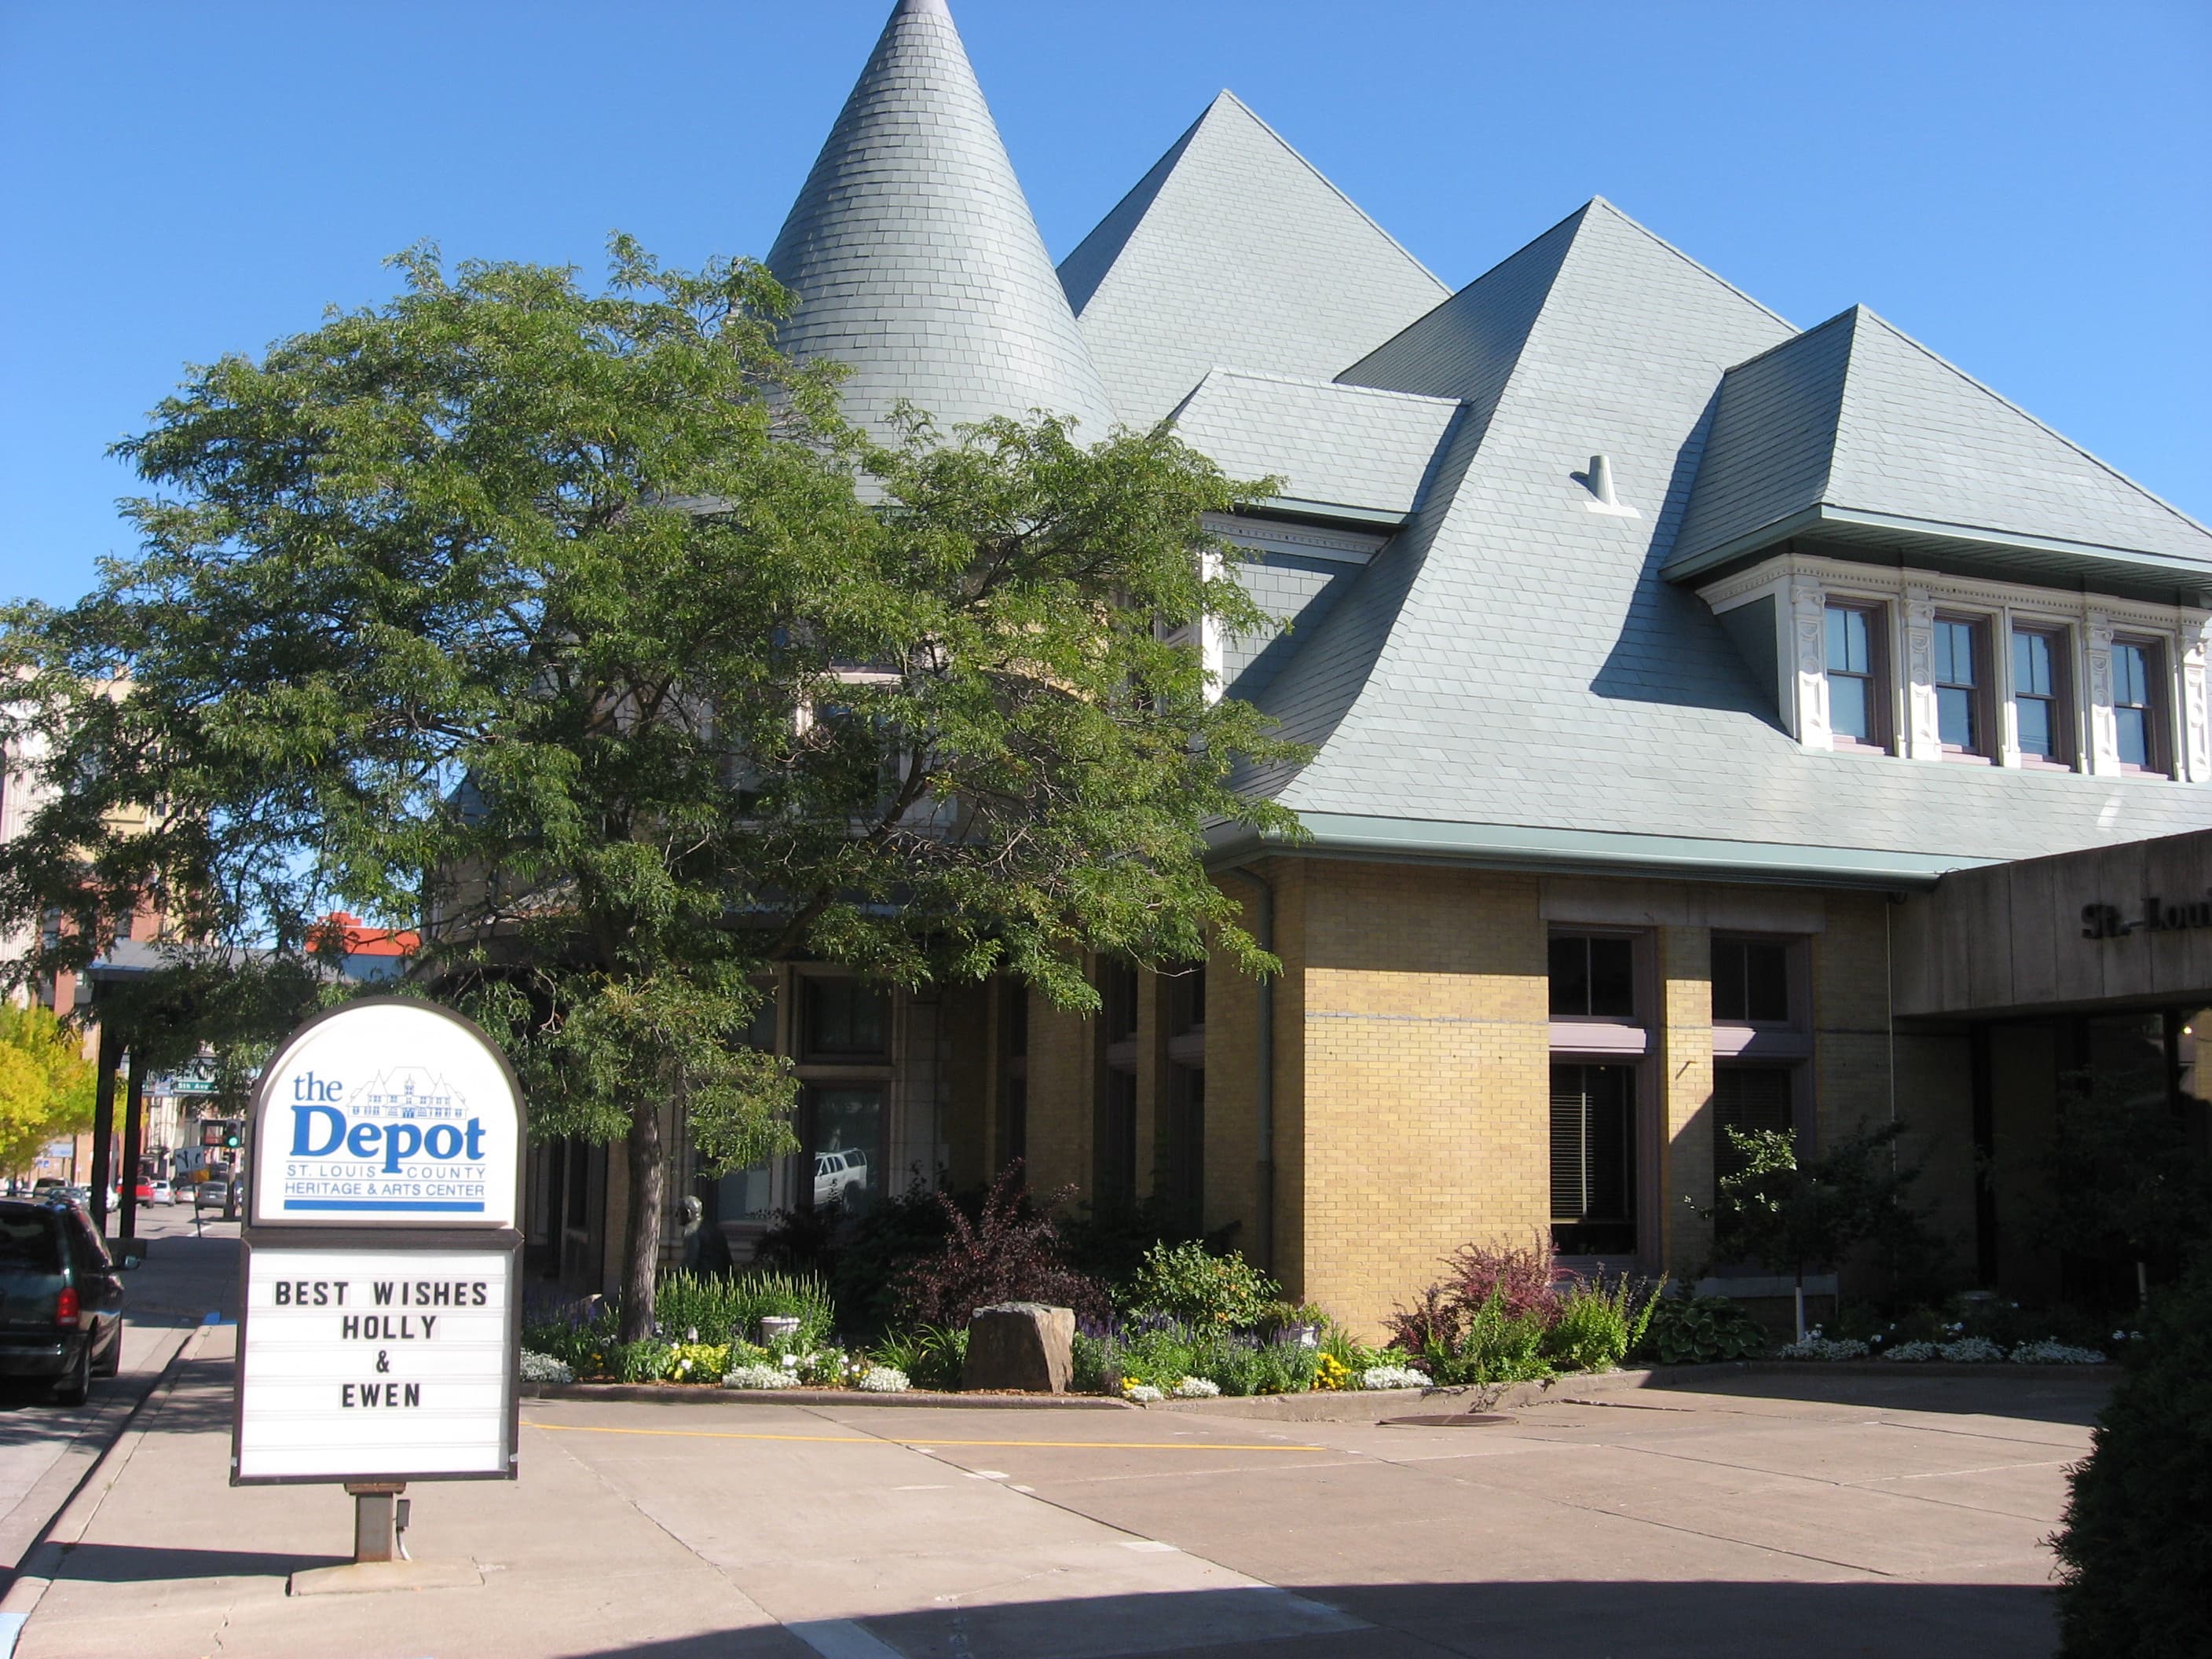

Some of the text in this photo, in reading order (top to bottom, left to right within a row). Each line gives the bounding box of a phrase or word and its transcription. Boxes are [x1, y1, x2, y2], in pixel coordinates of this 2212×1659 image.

[293, 1071, 343, 1102] the
[289, 1104, 486, 1174] Depot
[287, 1165, 485, 1178] ST. LOUIS COUNTY
[285, 1182, 485, 1196] HERITAGE & ARTS CENTER
[276, 1281, 486, 1306] BEST WISHES
[342, 1316, 436, 1339] HOLLY
[376, 1350, 389, 1373] &
[342, 1384, 419, 1408] EWEN
